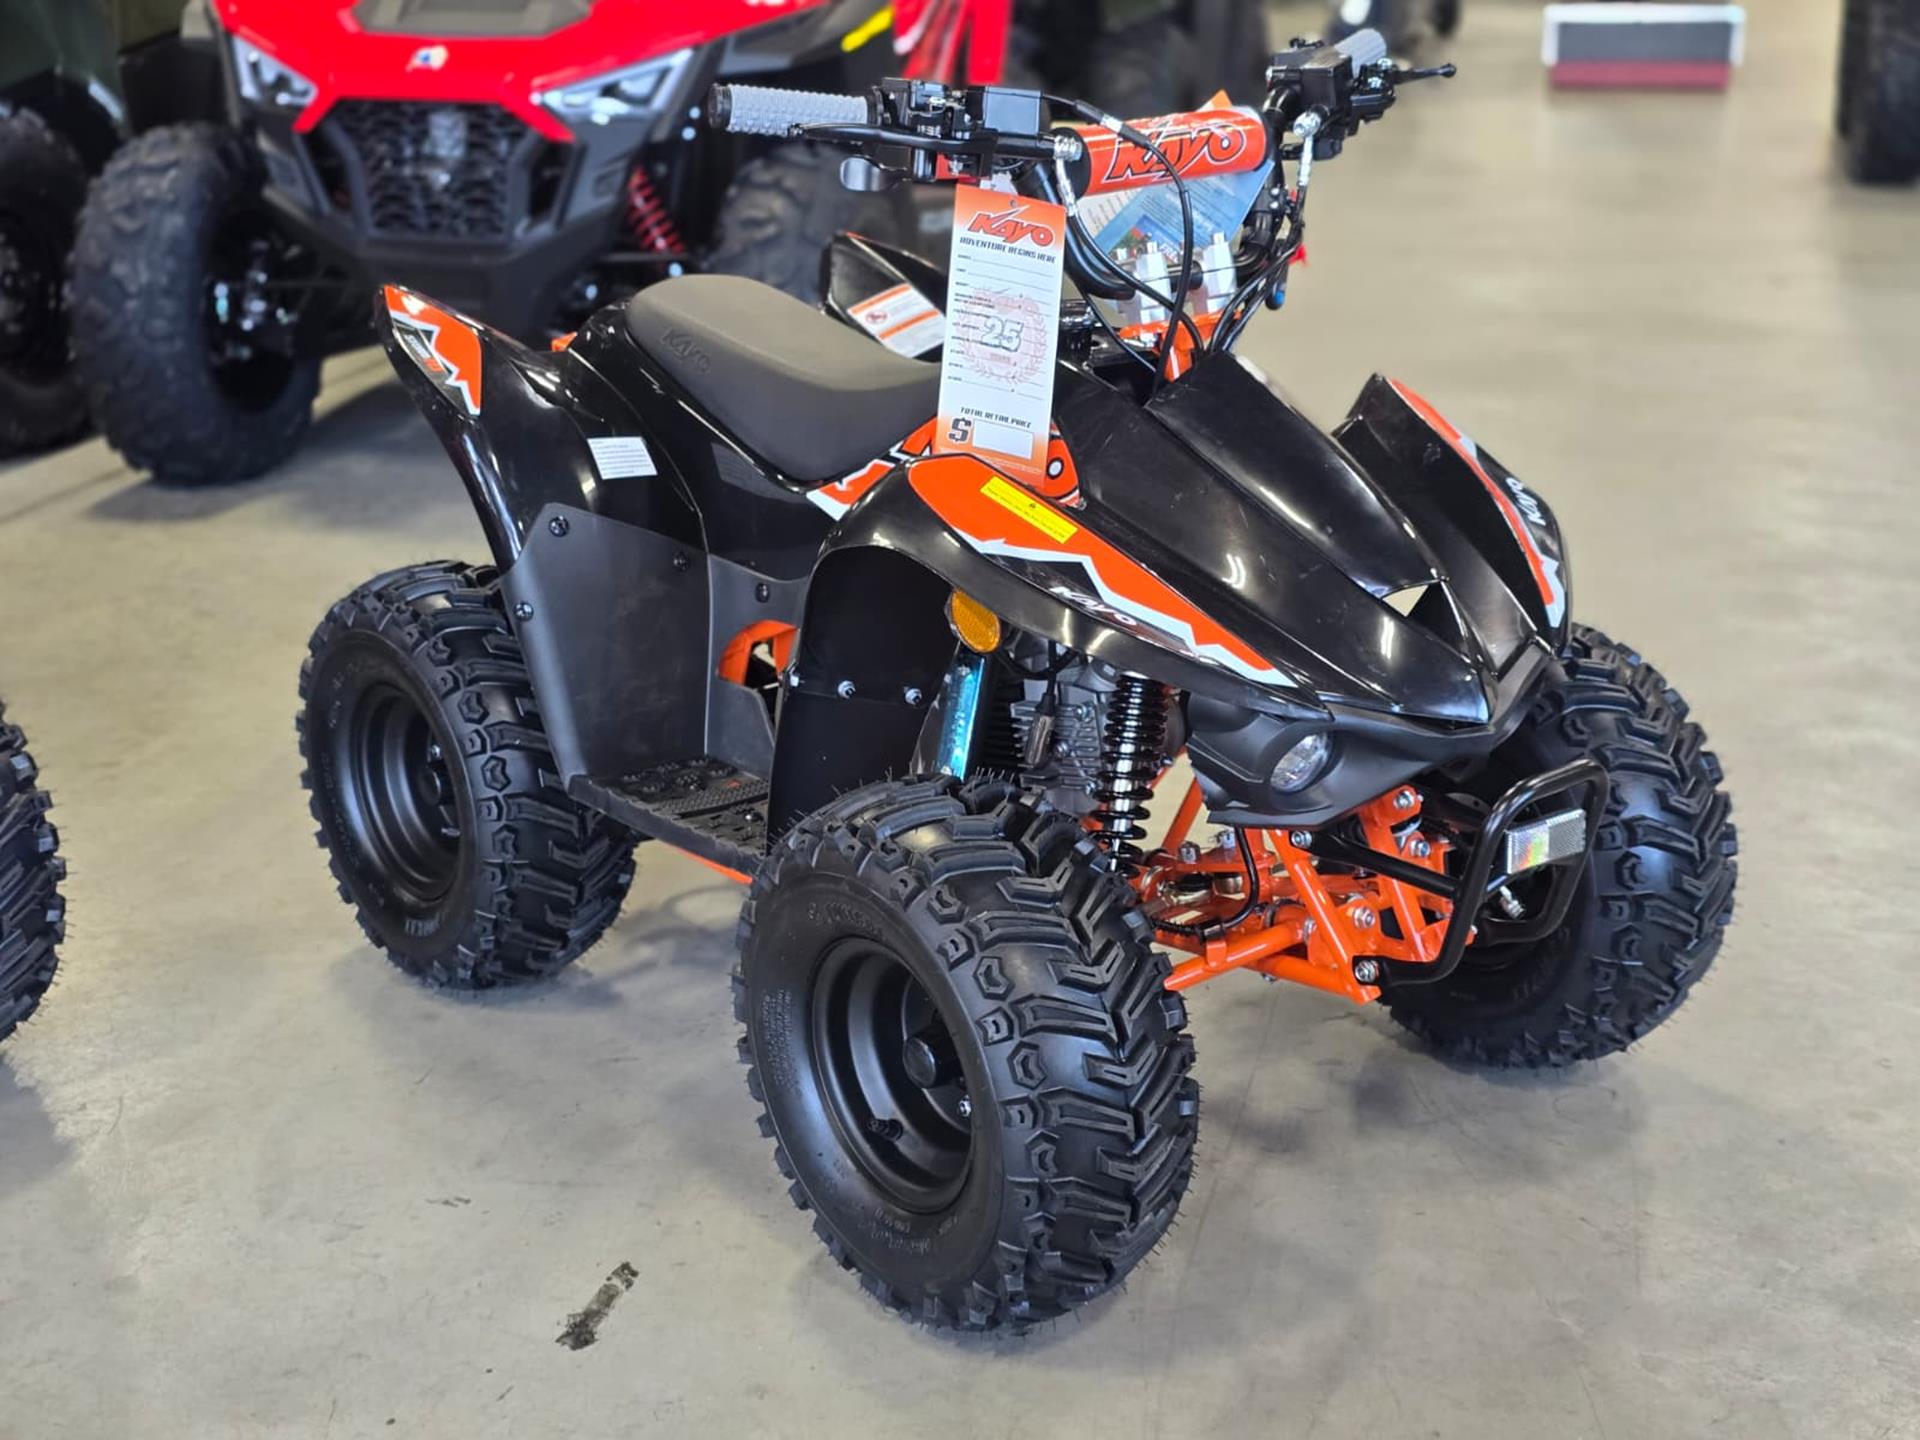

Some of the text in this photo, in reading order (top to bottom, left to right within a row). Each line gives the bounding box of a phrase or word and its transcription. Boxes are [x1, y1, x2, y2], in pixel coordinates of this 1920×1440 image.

[1103, 120, 1246, 182] KAYO
[968, 205, 1055, 248] KAYO
[959, 236, 1056, 264] ADVENTURE BEGINS HERE
[663, 328, 713, 375] KAYO
[948, 417, 972, 442] $
[960, 406, 1032, 429] TOTAL RETAIL PRICE
